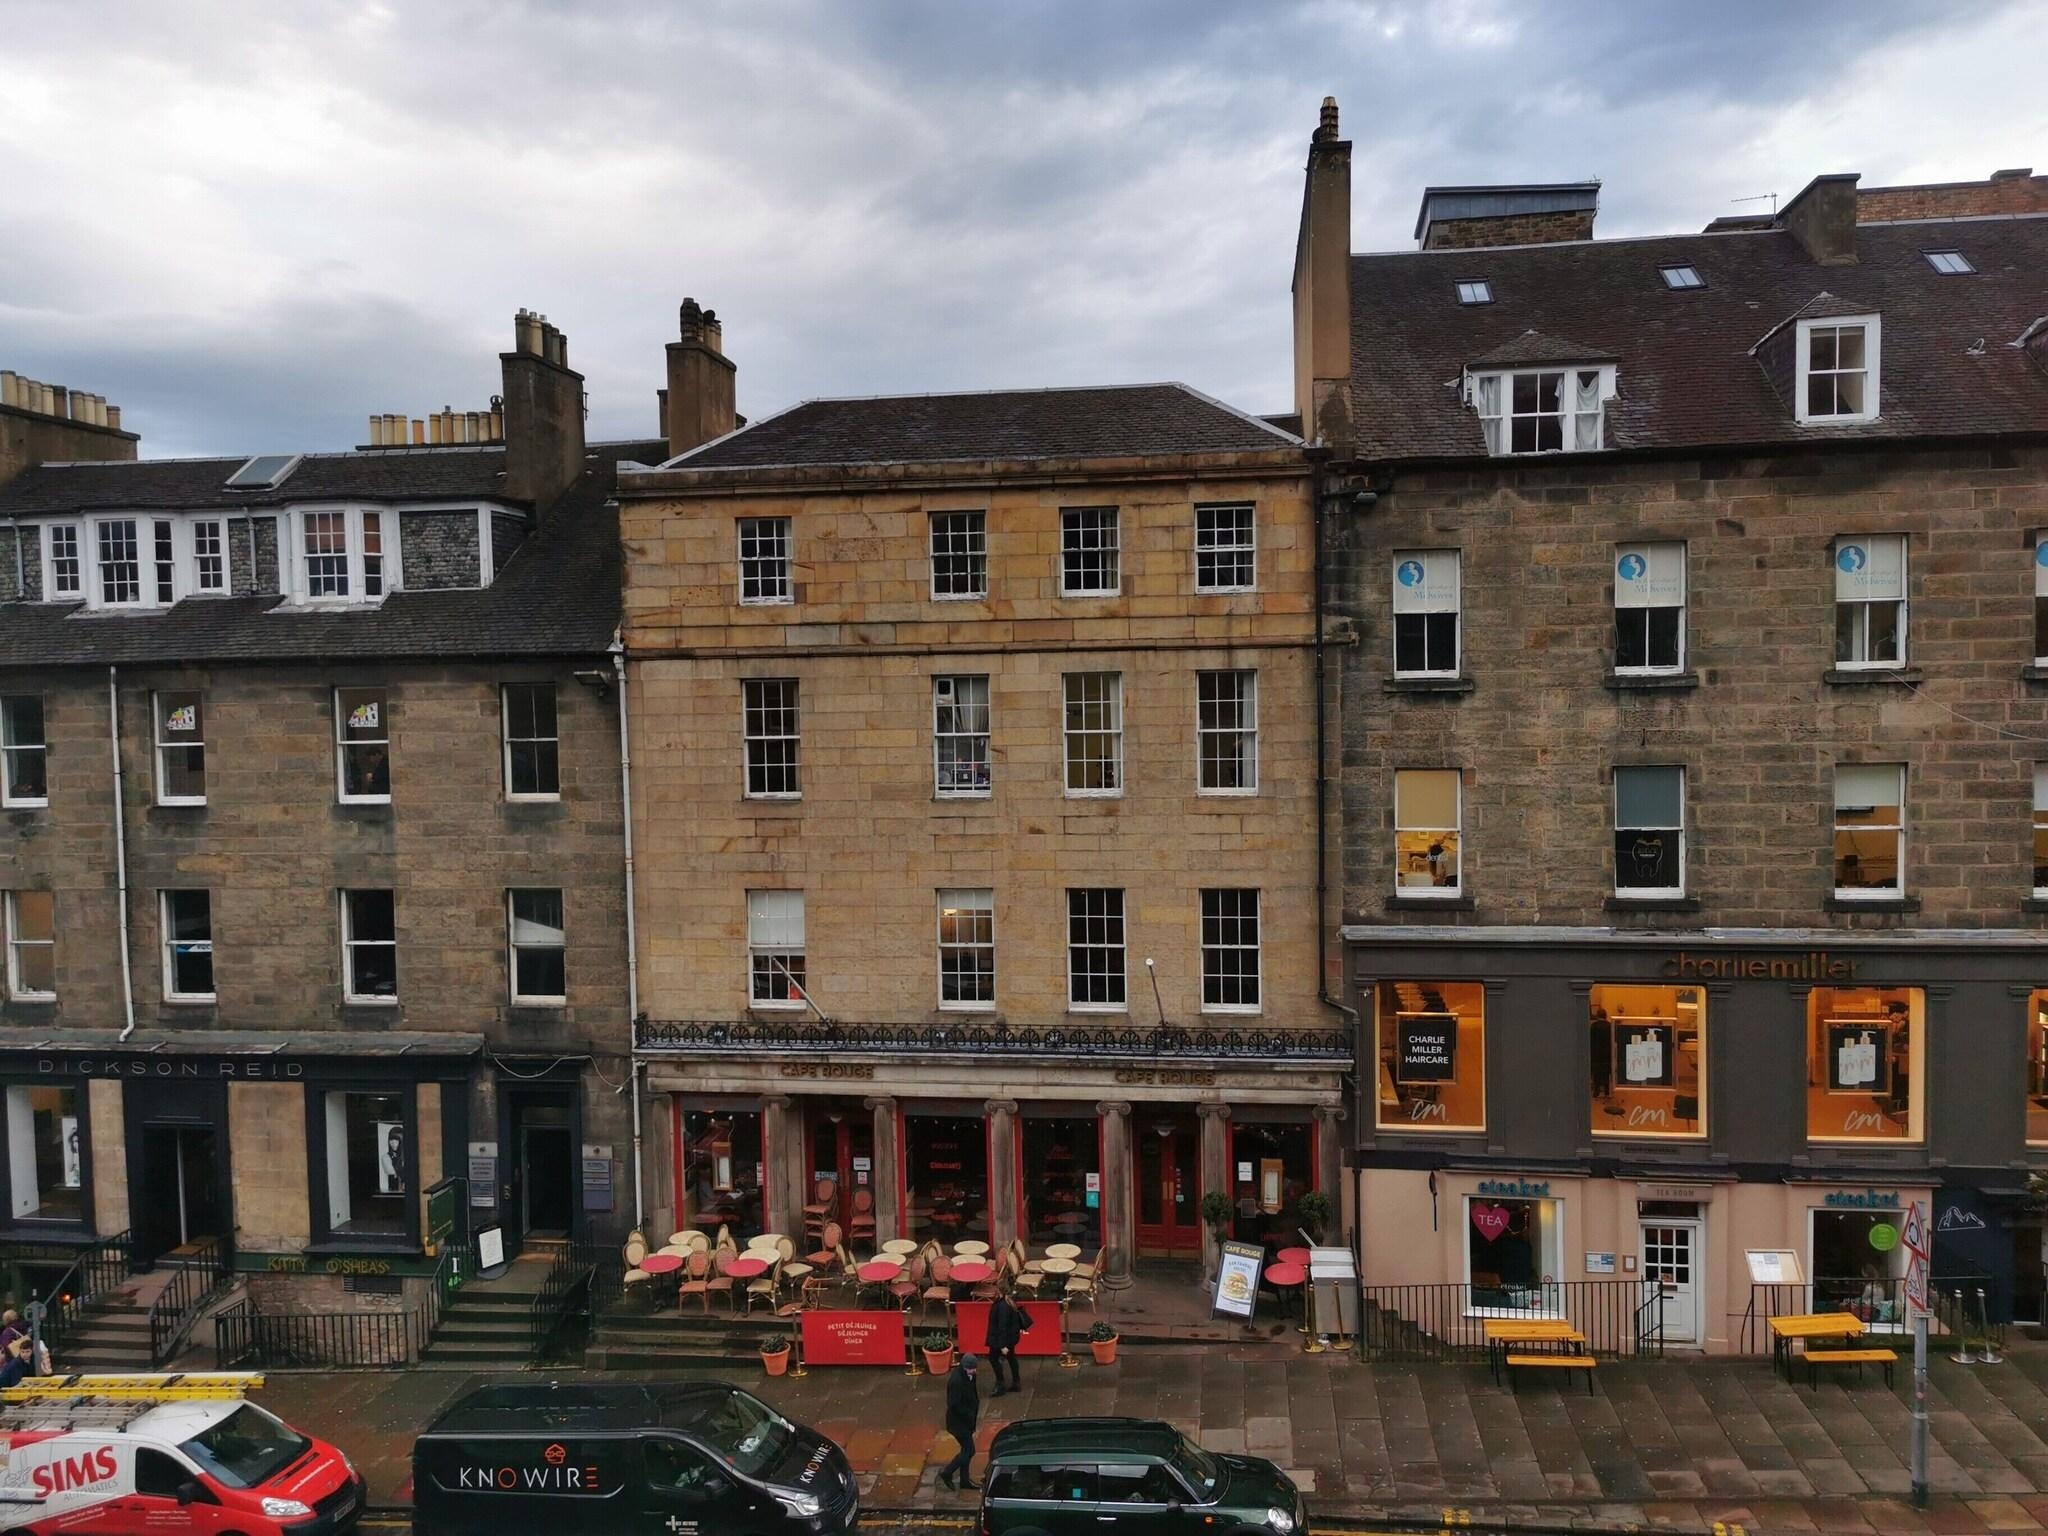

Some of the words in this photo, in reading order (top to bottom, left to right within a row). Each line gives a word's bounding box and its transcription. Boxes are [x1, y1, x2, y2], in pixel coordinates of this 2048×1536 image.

[1662, 952, 1861, 978] charliemiller
[1408, 1035, 1446, 1044] CHARLIE
[1411, 1045, 1443, 1054] MILLER
[1404, 1055, 1449, 1064] HAIRCARE
[39, 1060, 198, 1077] DICKSON
[219, 1063, 303, 1077] REID
[823, 1064, 875, 1080] ROUGE
[1160, 1069, 1217, 1086] ROUGE
[1478, 1214, 1503, 1226] TEA
[1241, 1248, 1261, 1258] ROUGE
[267, 1256, 309, 1272] KITTY
[828, 1322, 844, 1330] PETIT
[799, 1442, 833, 1484] KNOWIRE
[32, 1445, 117, 1498] SIMS
[460, 1467, 599, 1489] KNOWIRE
[63, 1480, 119, 1502] AUTOMATICS
